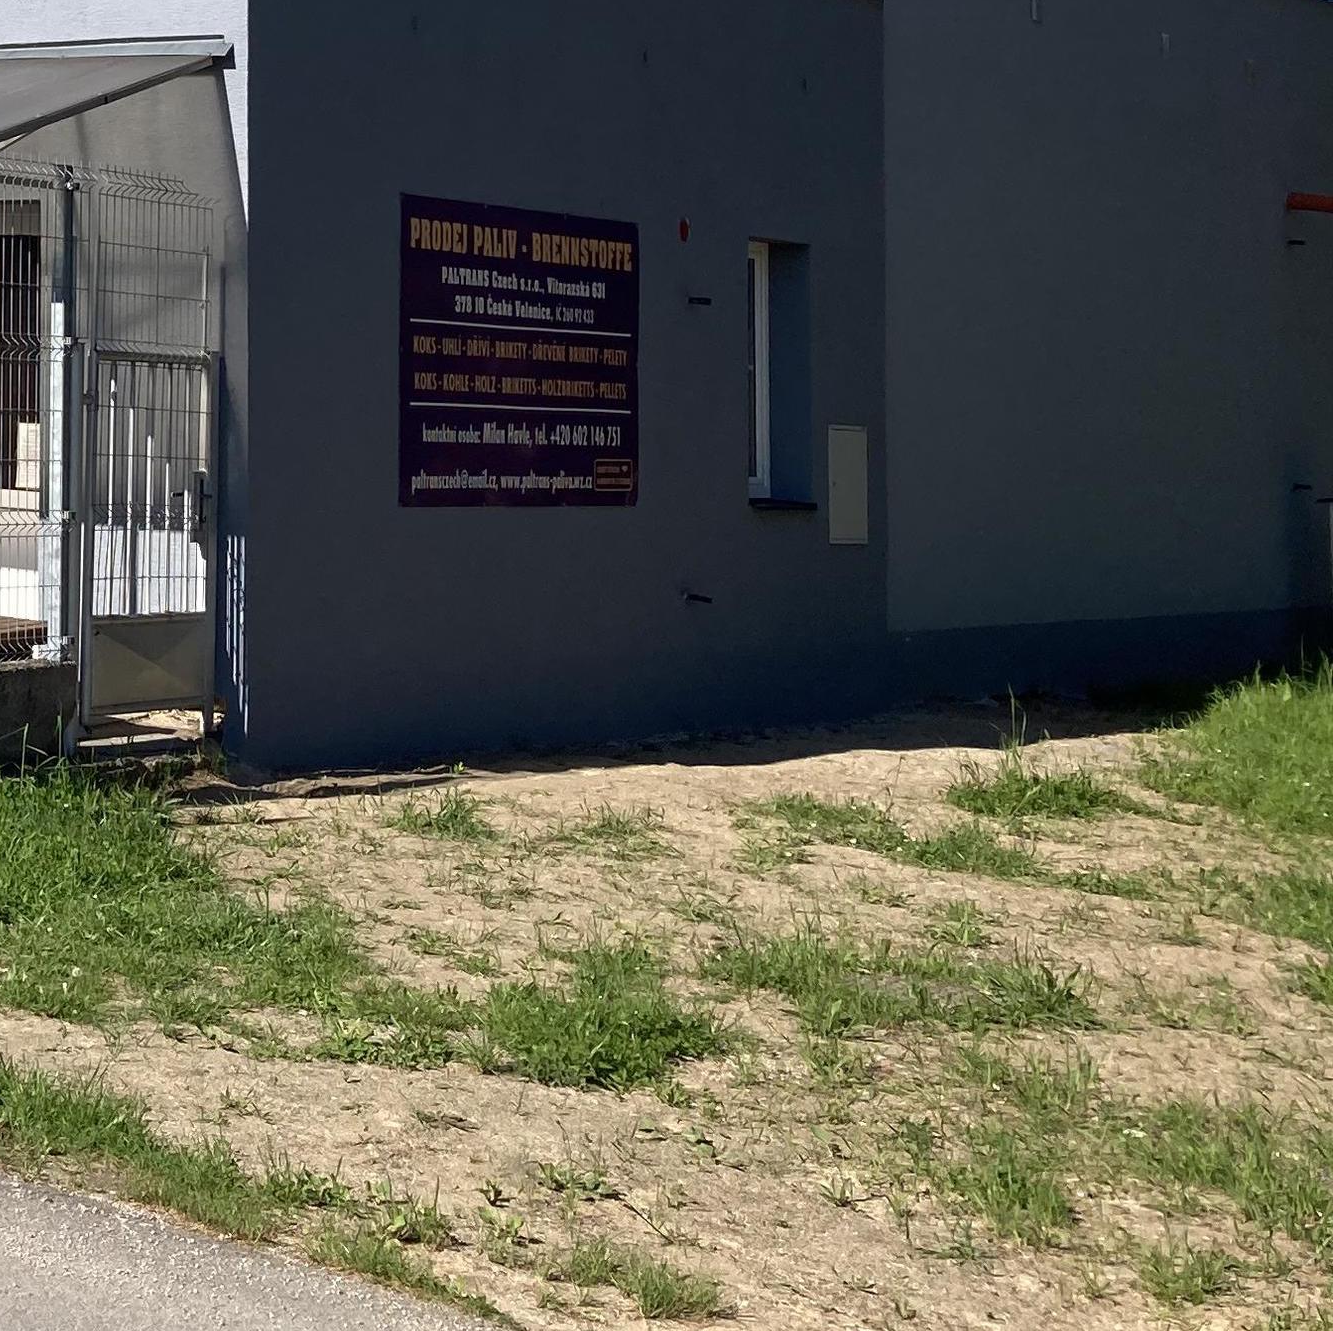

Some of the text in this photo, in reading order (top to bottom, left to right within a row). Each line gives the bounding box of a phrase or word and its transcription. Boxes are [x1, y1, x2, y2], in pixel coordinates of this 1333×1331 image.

[410, 217, 633, 272] PRODEJ PALIV BRENNSTOFFE
[441, 266, 489, 287] PALTRANS
[492, 271, 518, 291] Czech
[547, 277, 590, 298] Vitorazská
[592, 282, 606, 299] 631
[454, 295, 472, 314] 378
[475, 296, 485, 315] 10
[487, 293, 513, 318] České
[413, 335, 436, 355] KOKS
[442, 334, 461, 356] UHLÍ
[495, 341, 527, 360] BRIKETY
[568, 345, 599, 364] BRIKETY
[603, 348, 628, 367] PELETY
[414, 372, 627, 400] KOKS KOHLE HOLZ BRIKETTS HOLZBRIKETTS PELLETS
[483, 422, 506, 444] Milan
[535, 422, 548, 445] tel.
[550, 425, 571, 446] +420
[572, 425, 588, 446] 602
[590, 426, 605, 446] 146
[607, 426, 621, 447] 751
